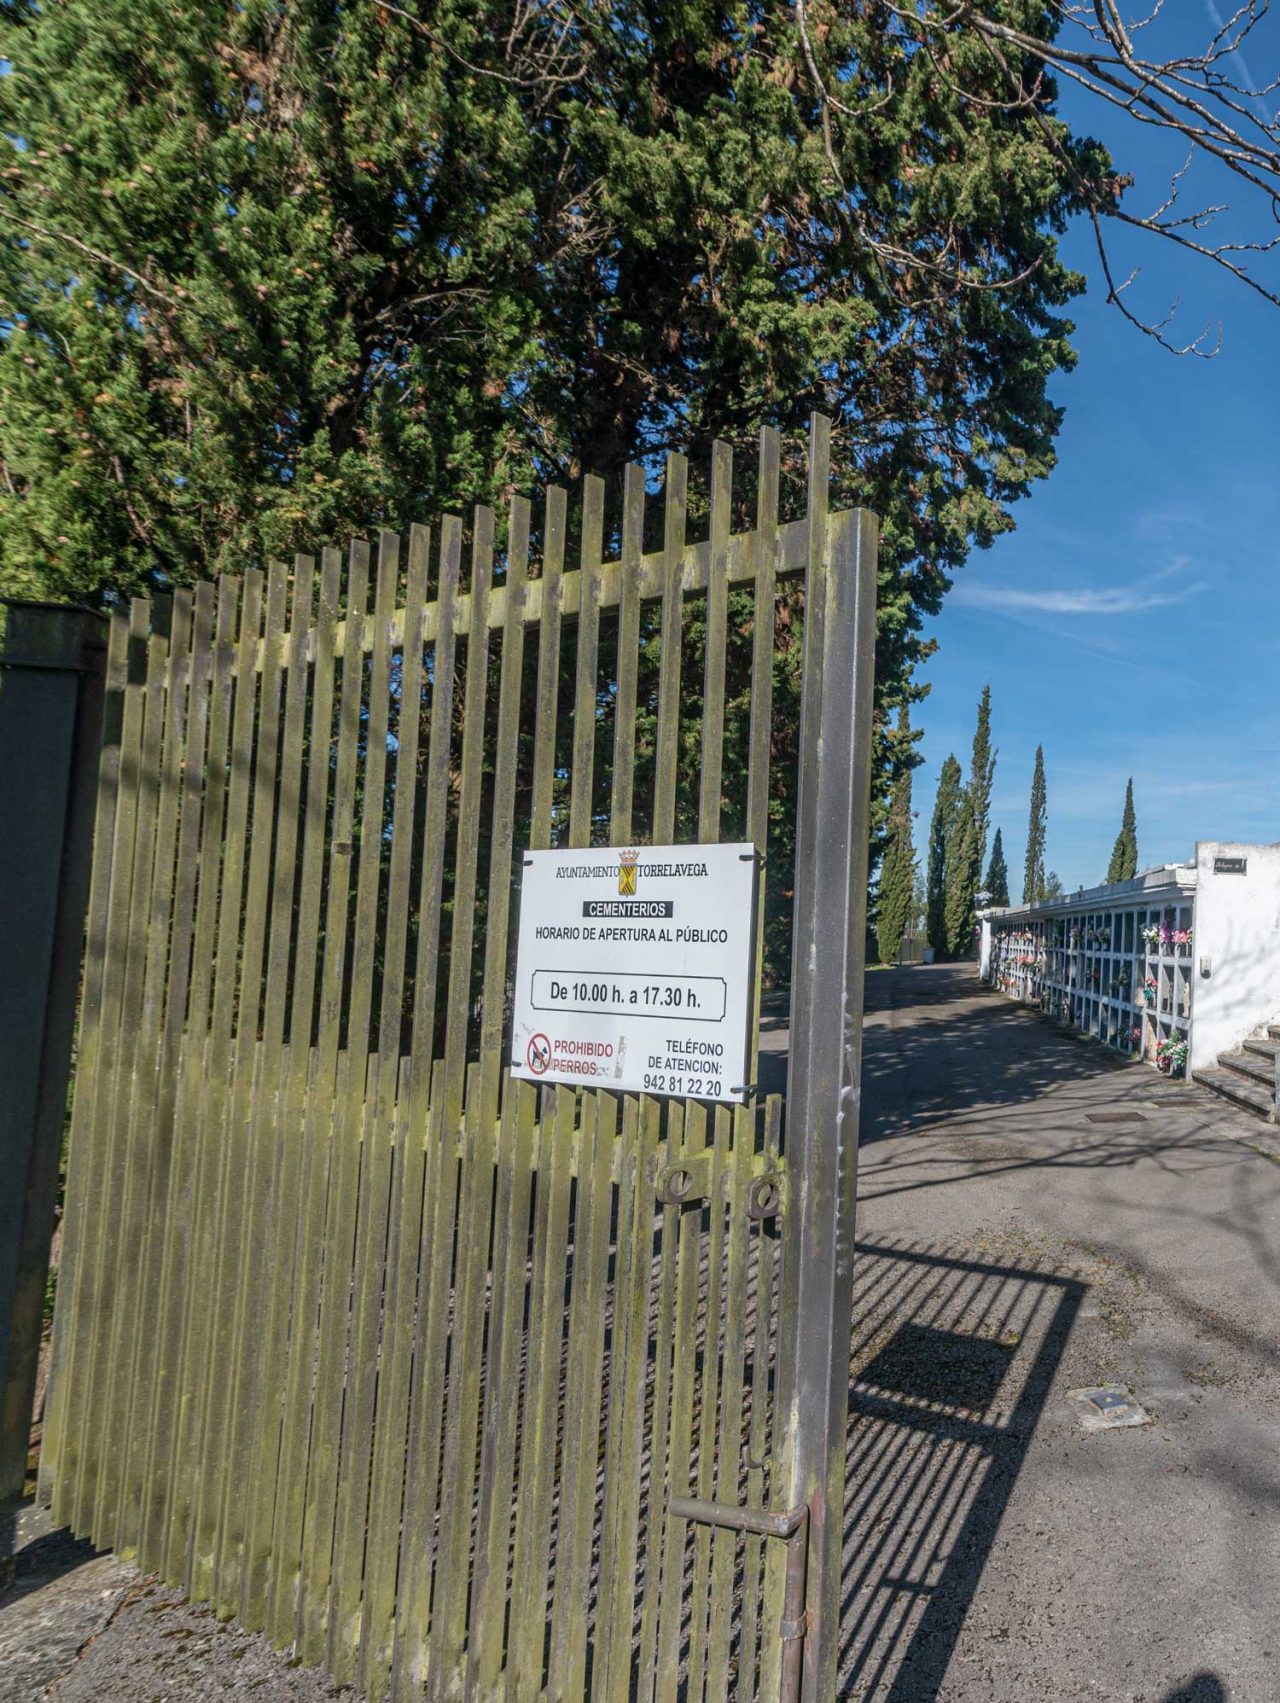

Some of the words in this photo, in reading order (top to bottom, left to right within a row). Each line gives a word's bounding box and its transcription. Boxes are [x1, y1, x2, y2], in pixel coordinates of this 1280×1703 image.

[556, 864, 619, 879] AYUNTAMIENTO
[638, 863, 708, 877] TORRELAVEGA
[589, 902, 666, 917] CEMENTERIOS
[536, 926, 580, 940] HORARIO
[582, 927, 596, 941] DE
[598, 928, 657, 942] APERTURA
[658, 928, 673, 942] AL
[676, 925, 728, 943] PÚBLICO
[551, 981, 568, 1000] De
[572, 982, 608, 1002] 10.00
[612, 985, 624, 1003] h.
[629, 991, 638, 1004] a
[643, 986, 682, 1006] 17.30
[687, 988, 701, 1008] h.
[554, 1039, 614, 1057] PROHIBIDO
[666, 1038, 724, 1056] TELÉFONO
[553, 1058, 597, 1075] PERROS
[648, 1056, 662, 1069] DE
[664, 1057, 722, 1075] ATENCION:
[643, 1073, 665, 1090] 942
[668, 1075, 682, 1092] 81
[687, 1078, 702, 1094] 22
[706, 1080, 721, 1097] 20
